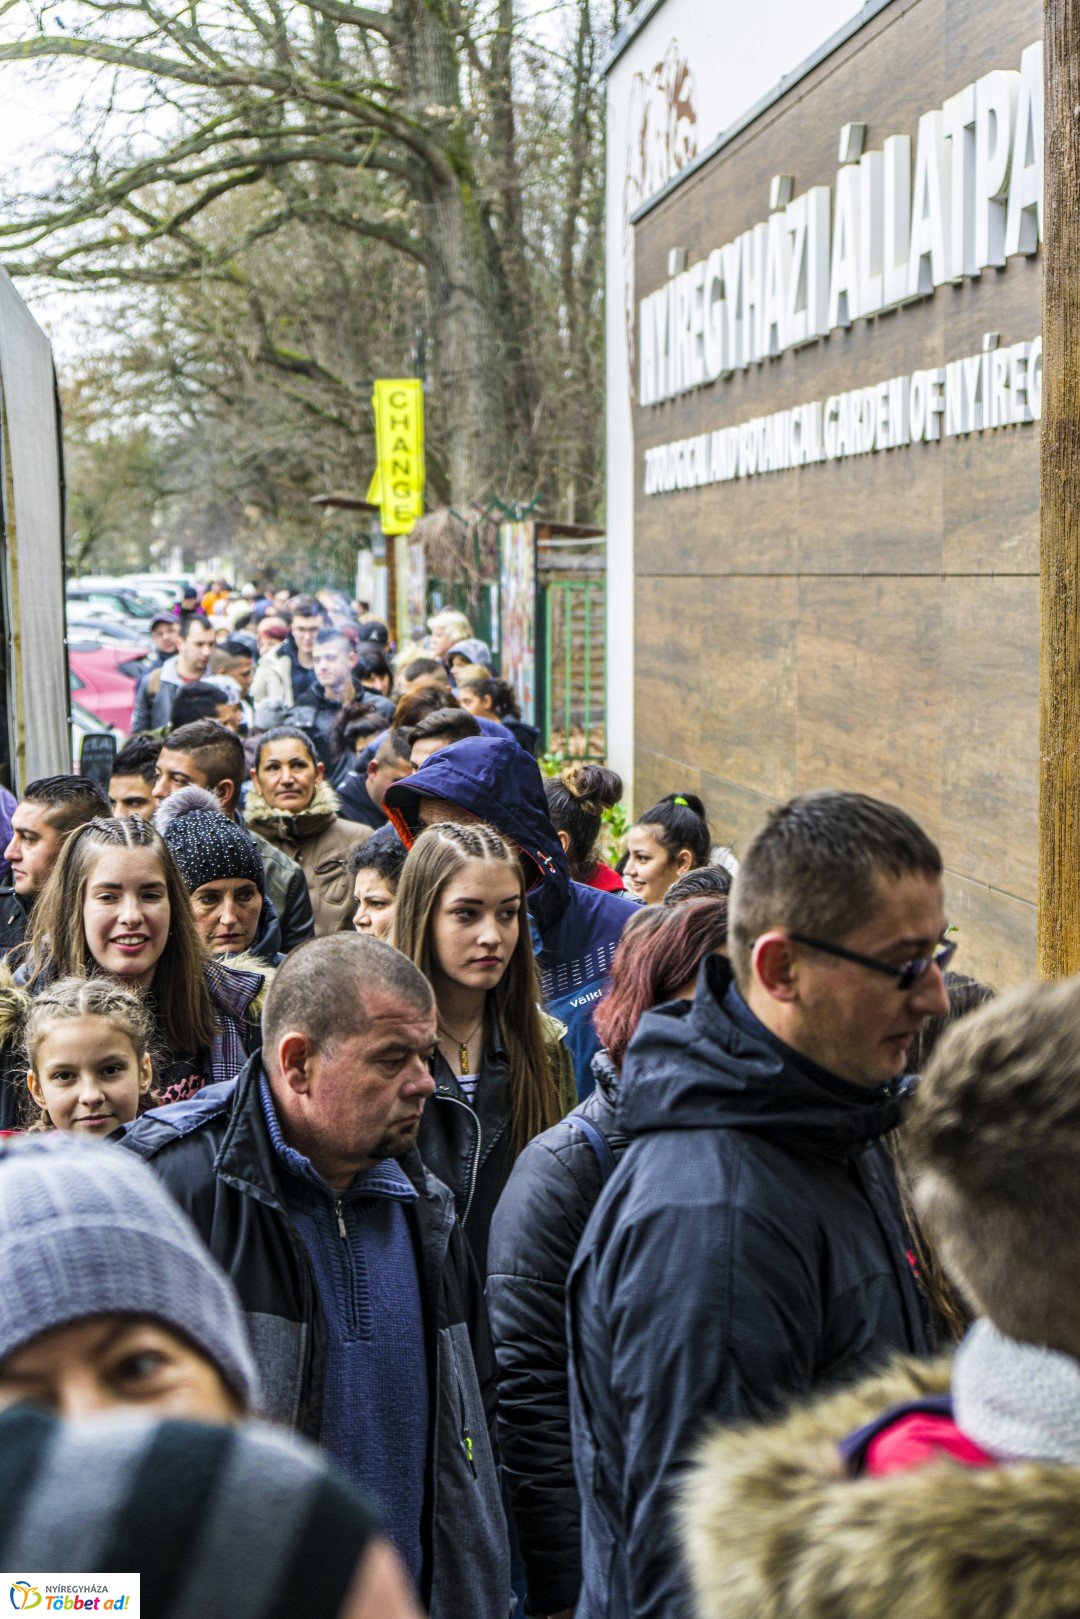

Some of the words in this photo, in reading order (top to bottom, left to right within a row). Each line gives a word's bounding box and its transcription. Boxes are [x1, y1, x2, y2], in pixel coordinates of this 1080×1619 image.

[640, 175, 831, 406] NYÍREGYHÁZI
[389, 390, 412, 522] CHANGE
[824, 376, 910, 460] GARDEN
[910, 368, 945, 442] OF
